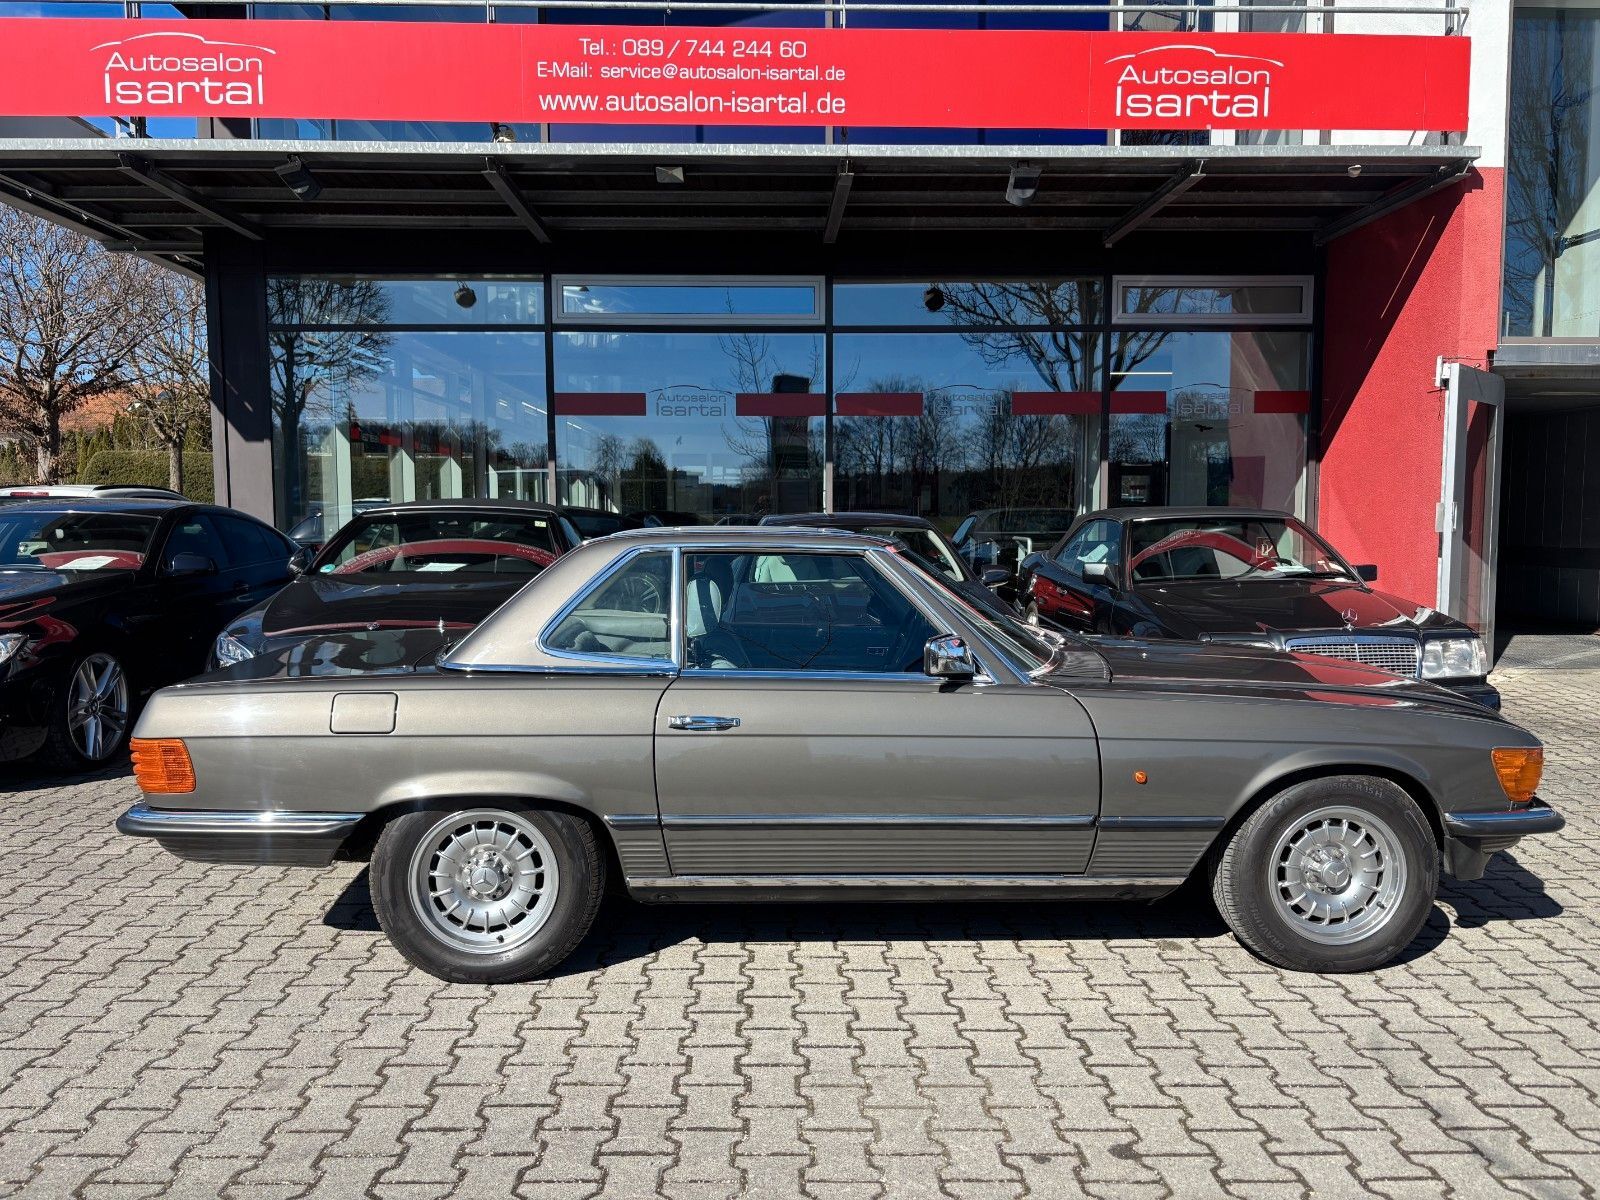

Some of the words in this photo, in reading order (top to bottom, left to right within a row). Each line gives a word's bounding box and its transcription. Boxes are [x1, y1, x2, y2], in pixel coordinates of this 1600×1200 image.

[579, 38, 616, 56] Tel.:
[622, 39, 664, 57] 089
[666, 40, 681, 59] /
[686, 40, 726, 57] 744
[733, 40, 773, 58] 244
[779, 41, 807, 59] 60
[105, 52, 263, 73] Autosalon
[537, 62, 593, 78] E-Mail:
[600, 62, 846, 81] service@autosalon-isartal.de
[1117, 65, 1270, 85] Autosalon
[104, 73, 264, 106] Isartal
[538, 90, 846, 114] www.autosalon-isartal.de
[1115, 86, 1271, 118] Isartal
[657, 392, 727, 402] Autosalon
[656, 402, 727, 417] Isartal
